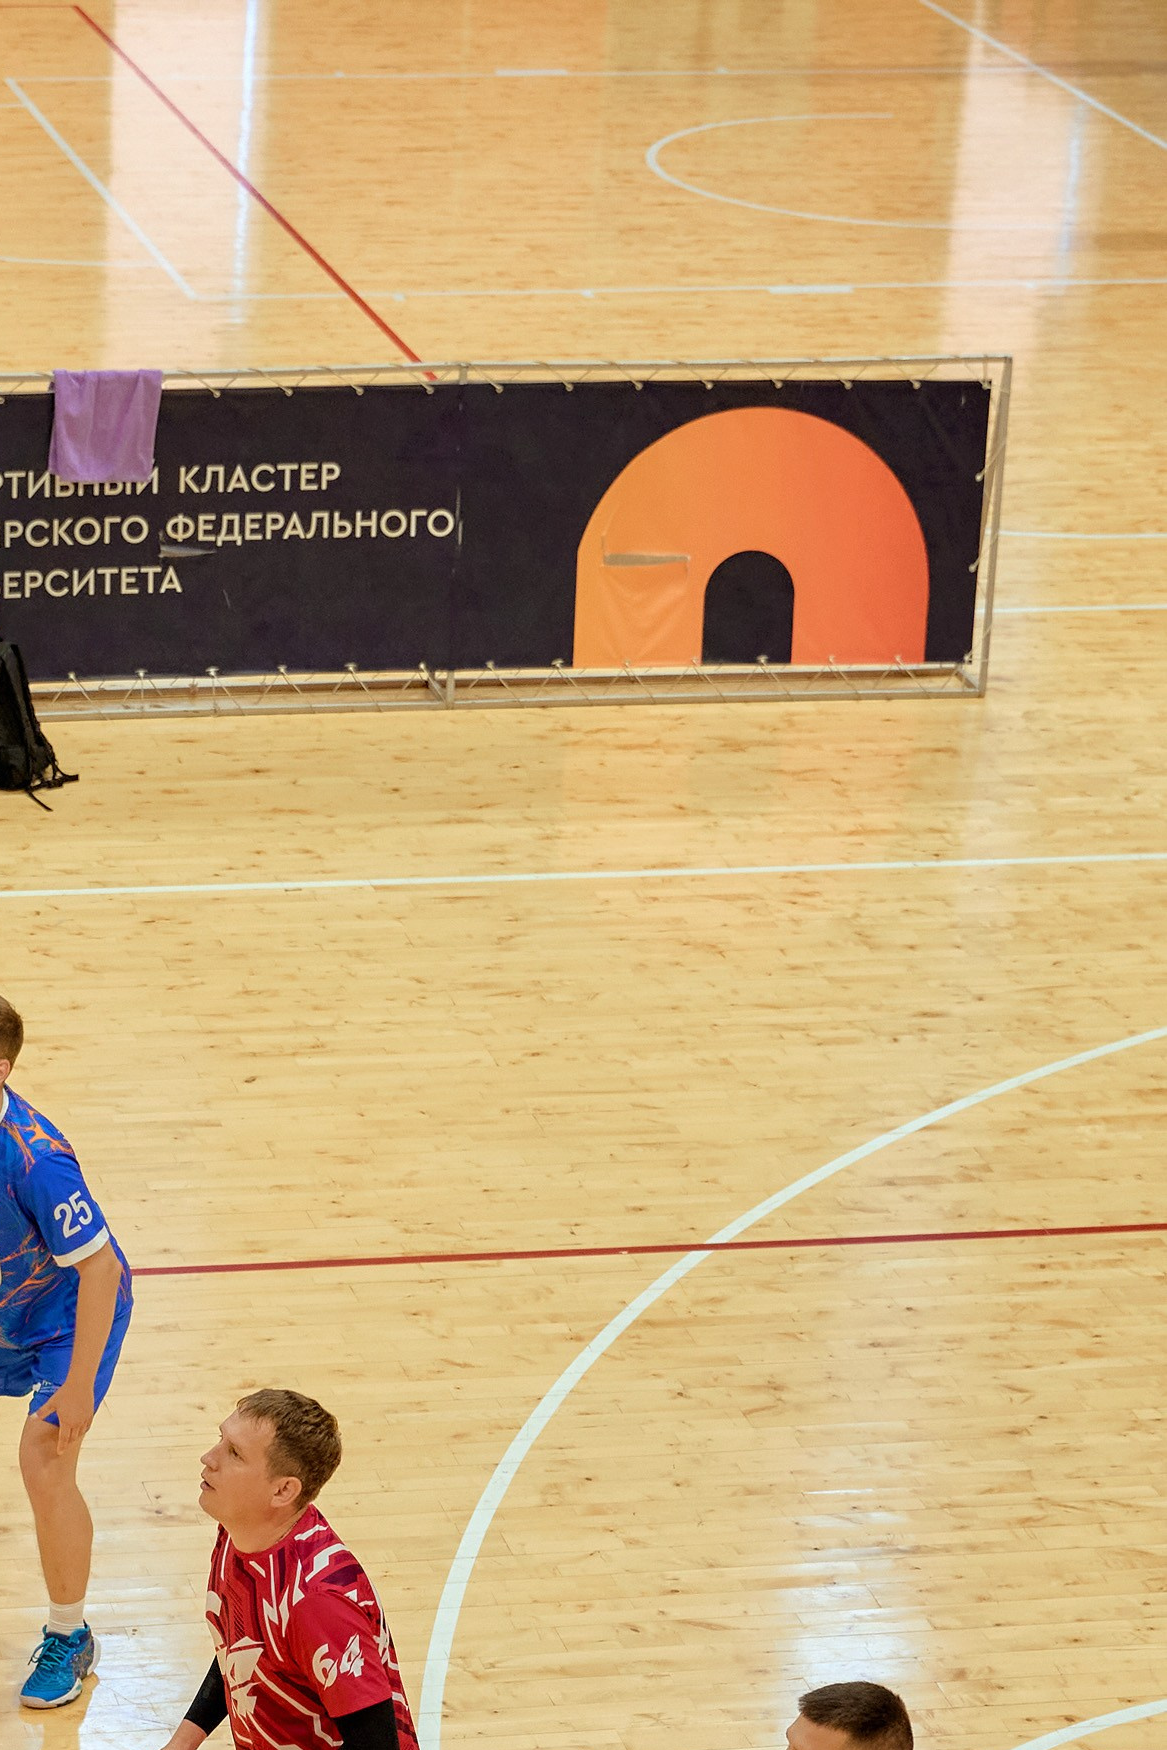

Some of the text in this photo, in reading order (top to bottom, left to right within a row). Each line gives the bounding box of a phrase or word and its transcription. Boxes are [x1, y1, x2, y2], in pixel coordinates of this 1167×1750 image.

[179, 461, 342, 494] КЛАСТЕР
[165, 508, 455, 547] ФЕДЕРАЛЬНОГО
[53, 1190, 94, 1239] 25
[312, 1633, 365, 1690] 64
